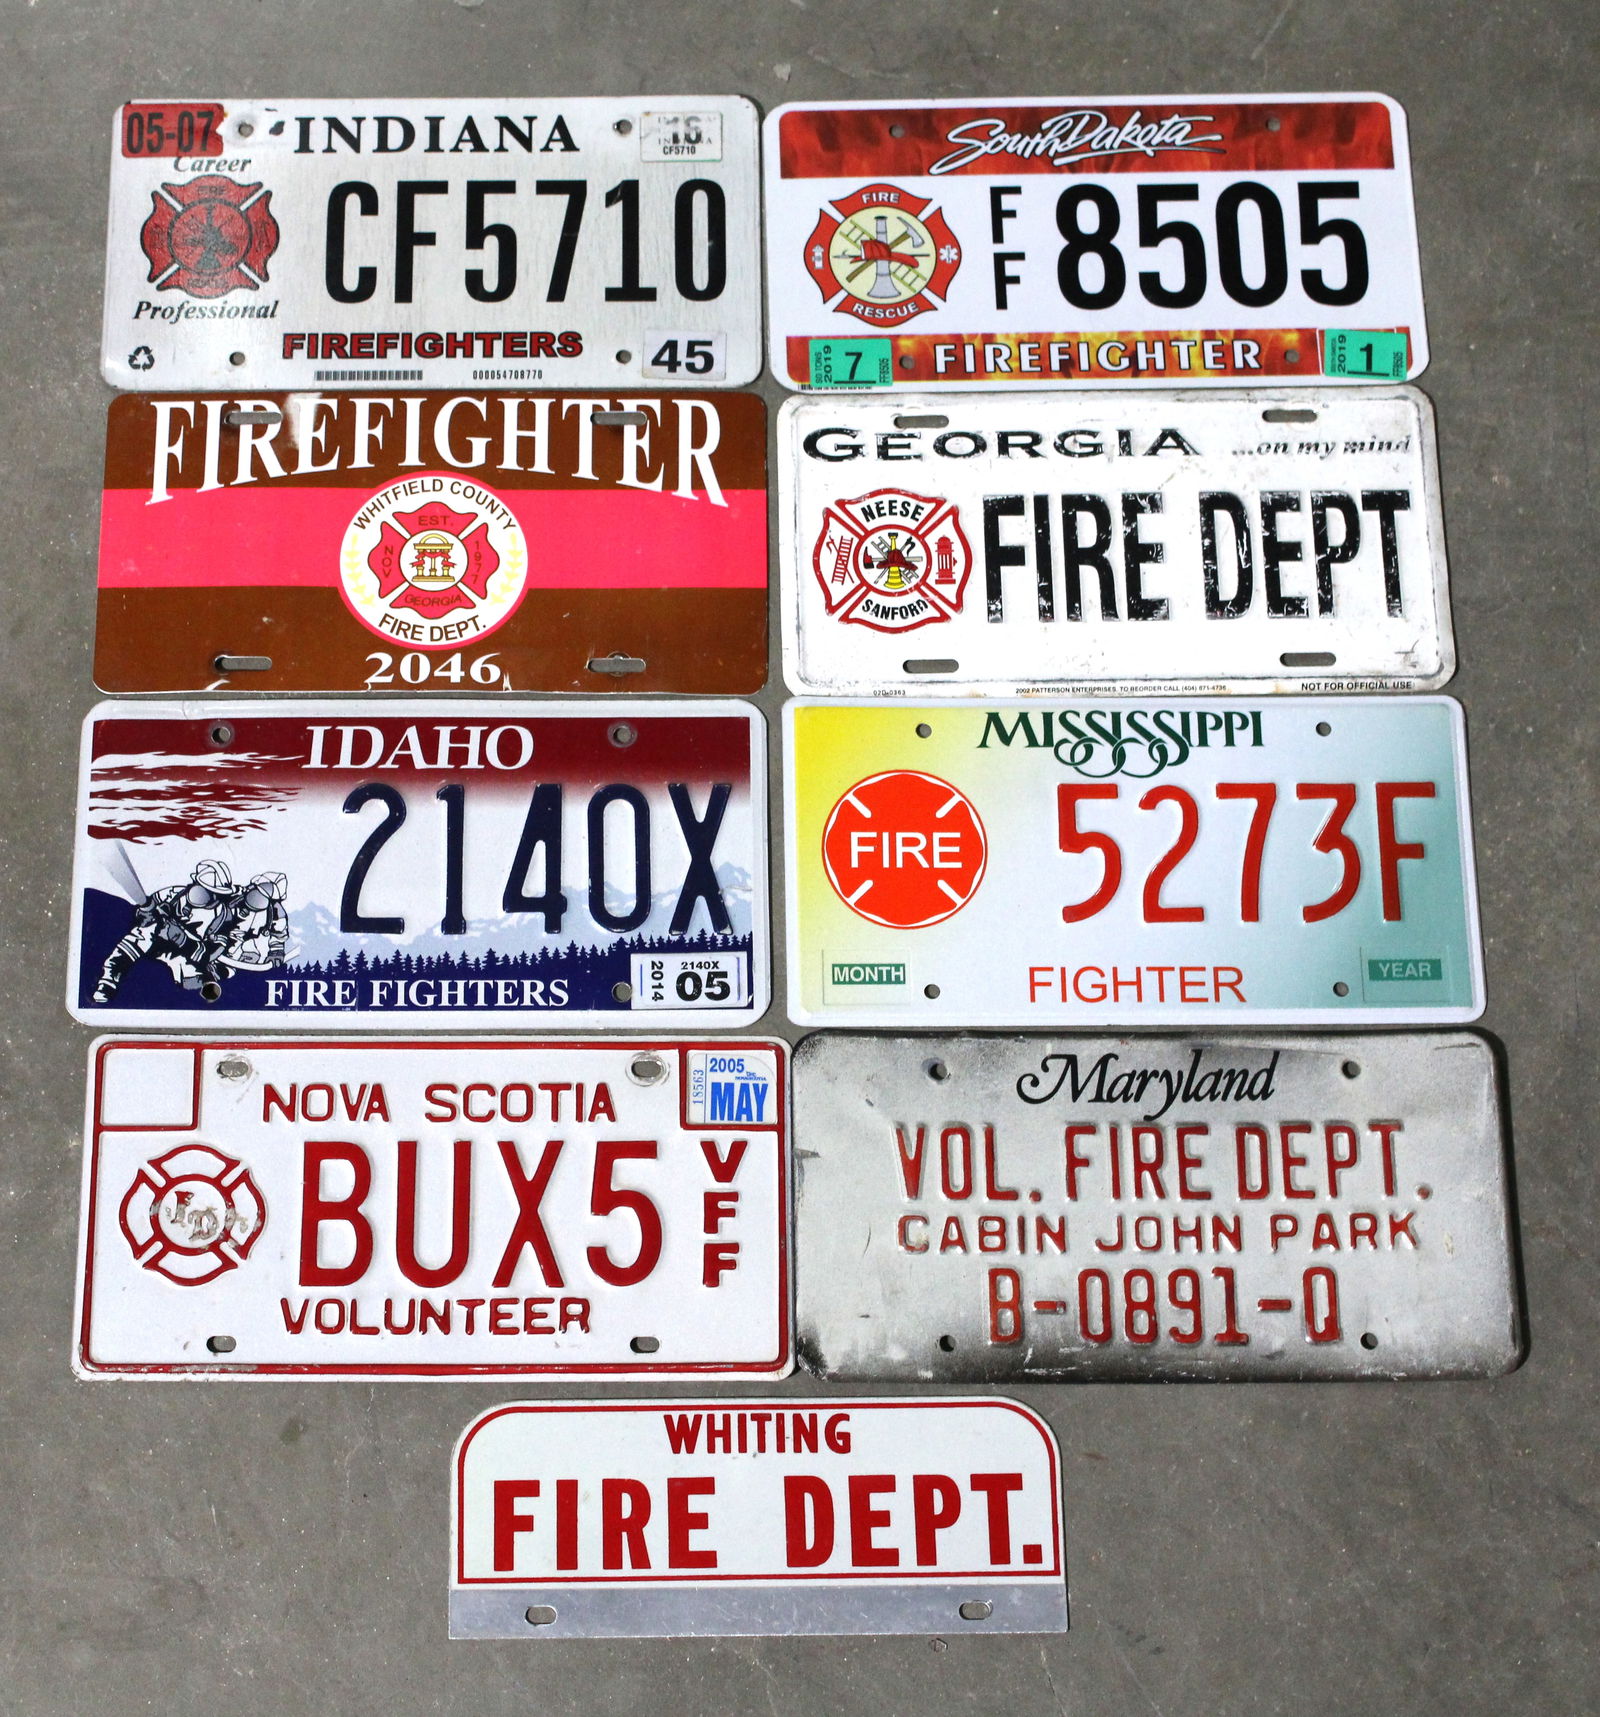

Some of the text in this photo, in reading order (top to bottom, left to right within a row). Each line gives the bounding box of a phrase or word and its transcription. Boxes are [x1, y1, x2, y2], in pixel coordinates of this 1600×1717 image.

[127, 111, 214, 154] 05-07
[294, 115, 580, 153] INDIANA
[662, 145, 697, 155] CF5710
[1040, 110, 1222, 158] Dakota
[173, 156, 252, 173] Career
[861, 191, 899, 204] FIRE
[325, 179, 727, 304] CF5710
[1055, 181, 1370, 310] 8505
[133, 299, 279, 325] Professional
[852, 301, 919, 319] RESCUE
[281, 331, 584, 360] FIREFIGHTERS
[651, 340, 715, 374] 45
[822, 344, 832, 384] 2019
[933, 340, 1263, 374] FIREFIGHTER
[1337, 334, 1346, 374] 2019
[1359, 343, 1373, 373] 1
[844, 350, 863, 381] 7
[145, 396, 729, 508] FIREFIGHTER
[802, 427, 1200, 462] GEORGIA
[1297, 441, 1336, 460] my
[1342, 435, 1411, 454] mind
[354, 478, 517, 531] WHITFIELD COUNTY
[417, 515, 455, 527] EST.
[861, 499, 924, 523] NEESE
[981, 489, 1411, 624] FIRE DEPT
[404, 594, 463, 608] GEORGIA
[861, 598, 929, 621] SANFORD
[378, 613, 487, 642] FIRE DEPT.
[363, 652, 502, 685] 2046
[1301, 681, 1413, 691] NOT FOR OFFICIAL USE
[301, 725, 534, 770] IDAHO
[977, 710, 1264, 779] MISSISSIPPI
[339, 783, 731, 935] 2140X
[849, 831, 963, 869] FIRE
[1057, 781, 1437, 924] 5273F
[651, 961, 664, 1001] 2014
[680, 961, 719, 970] 2140X
[833, 966, 904, 982] MONTH
[1379, 962, 1432, 978] YEAR
[265, 979, 570, 1007] FIRE FIGHTERS
[675, 971, 731, 1001] 05
[1028, 966, 1247, 1004] FIGHTER
[709, 1058, 745, 1073] 2005
[263, 1083, 617, 1125] NOVA SCOTIA
[692, 1069, 704, 1105] 18563
[710, 1082, 769, 1122] MAY
[1016, 1051, 1280, 1121] Maryland
[896, 1122, 1433, 1202] VOL. FIRE DEPT.
[300, 1139, 661, 1288] BUX5
[898, 1211, 1420, 1253] CABIN JOHN PARK
[280, 1298, 591, 1336] VOLUNTEER
[663, 1413, 851, 1455] WHITING
[493, 1473, 1043, 1572] FIRE DEPT.
